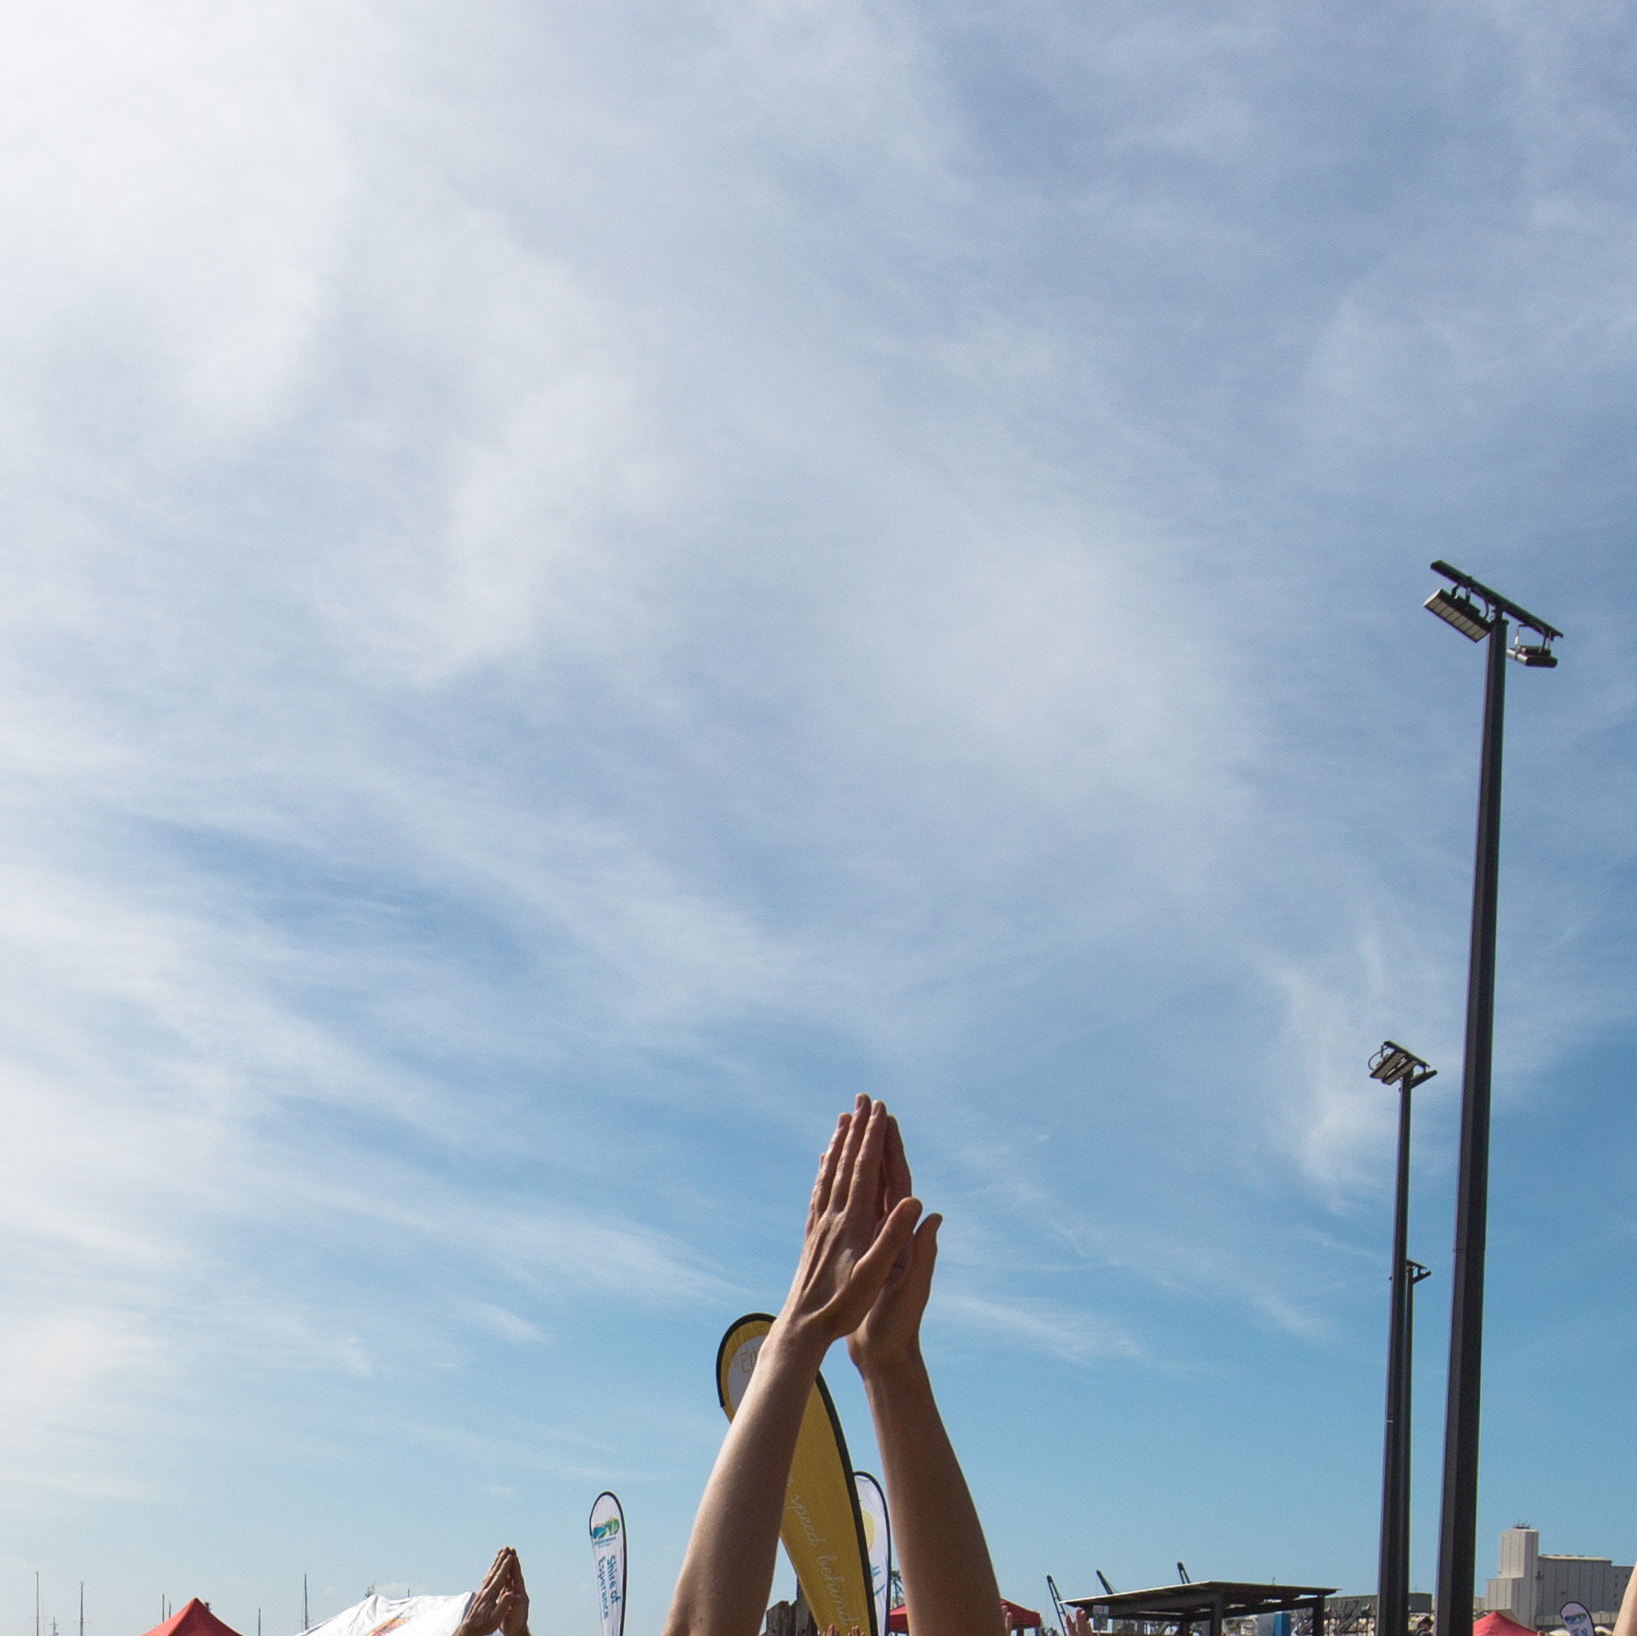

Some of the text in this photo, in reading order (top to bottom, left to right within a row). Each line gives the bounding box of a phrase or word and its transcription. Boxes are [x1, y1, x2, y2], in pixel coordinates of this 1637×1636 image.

[598, 1556, 609, 1620] Esperance
[607, 1554, 620, 1604] Shire of
[789, 1493, 859, 1626] speed behind
